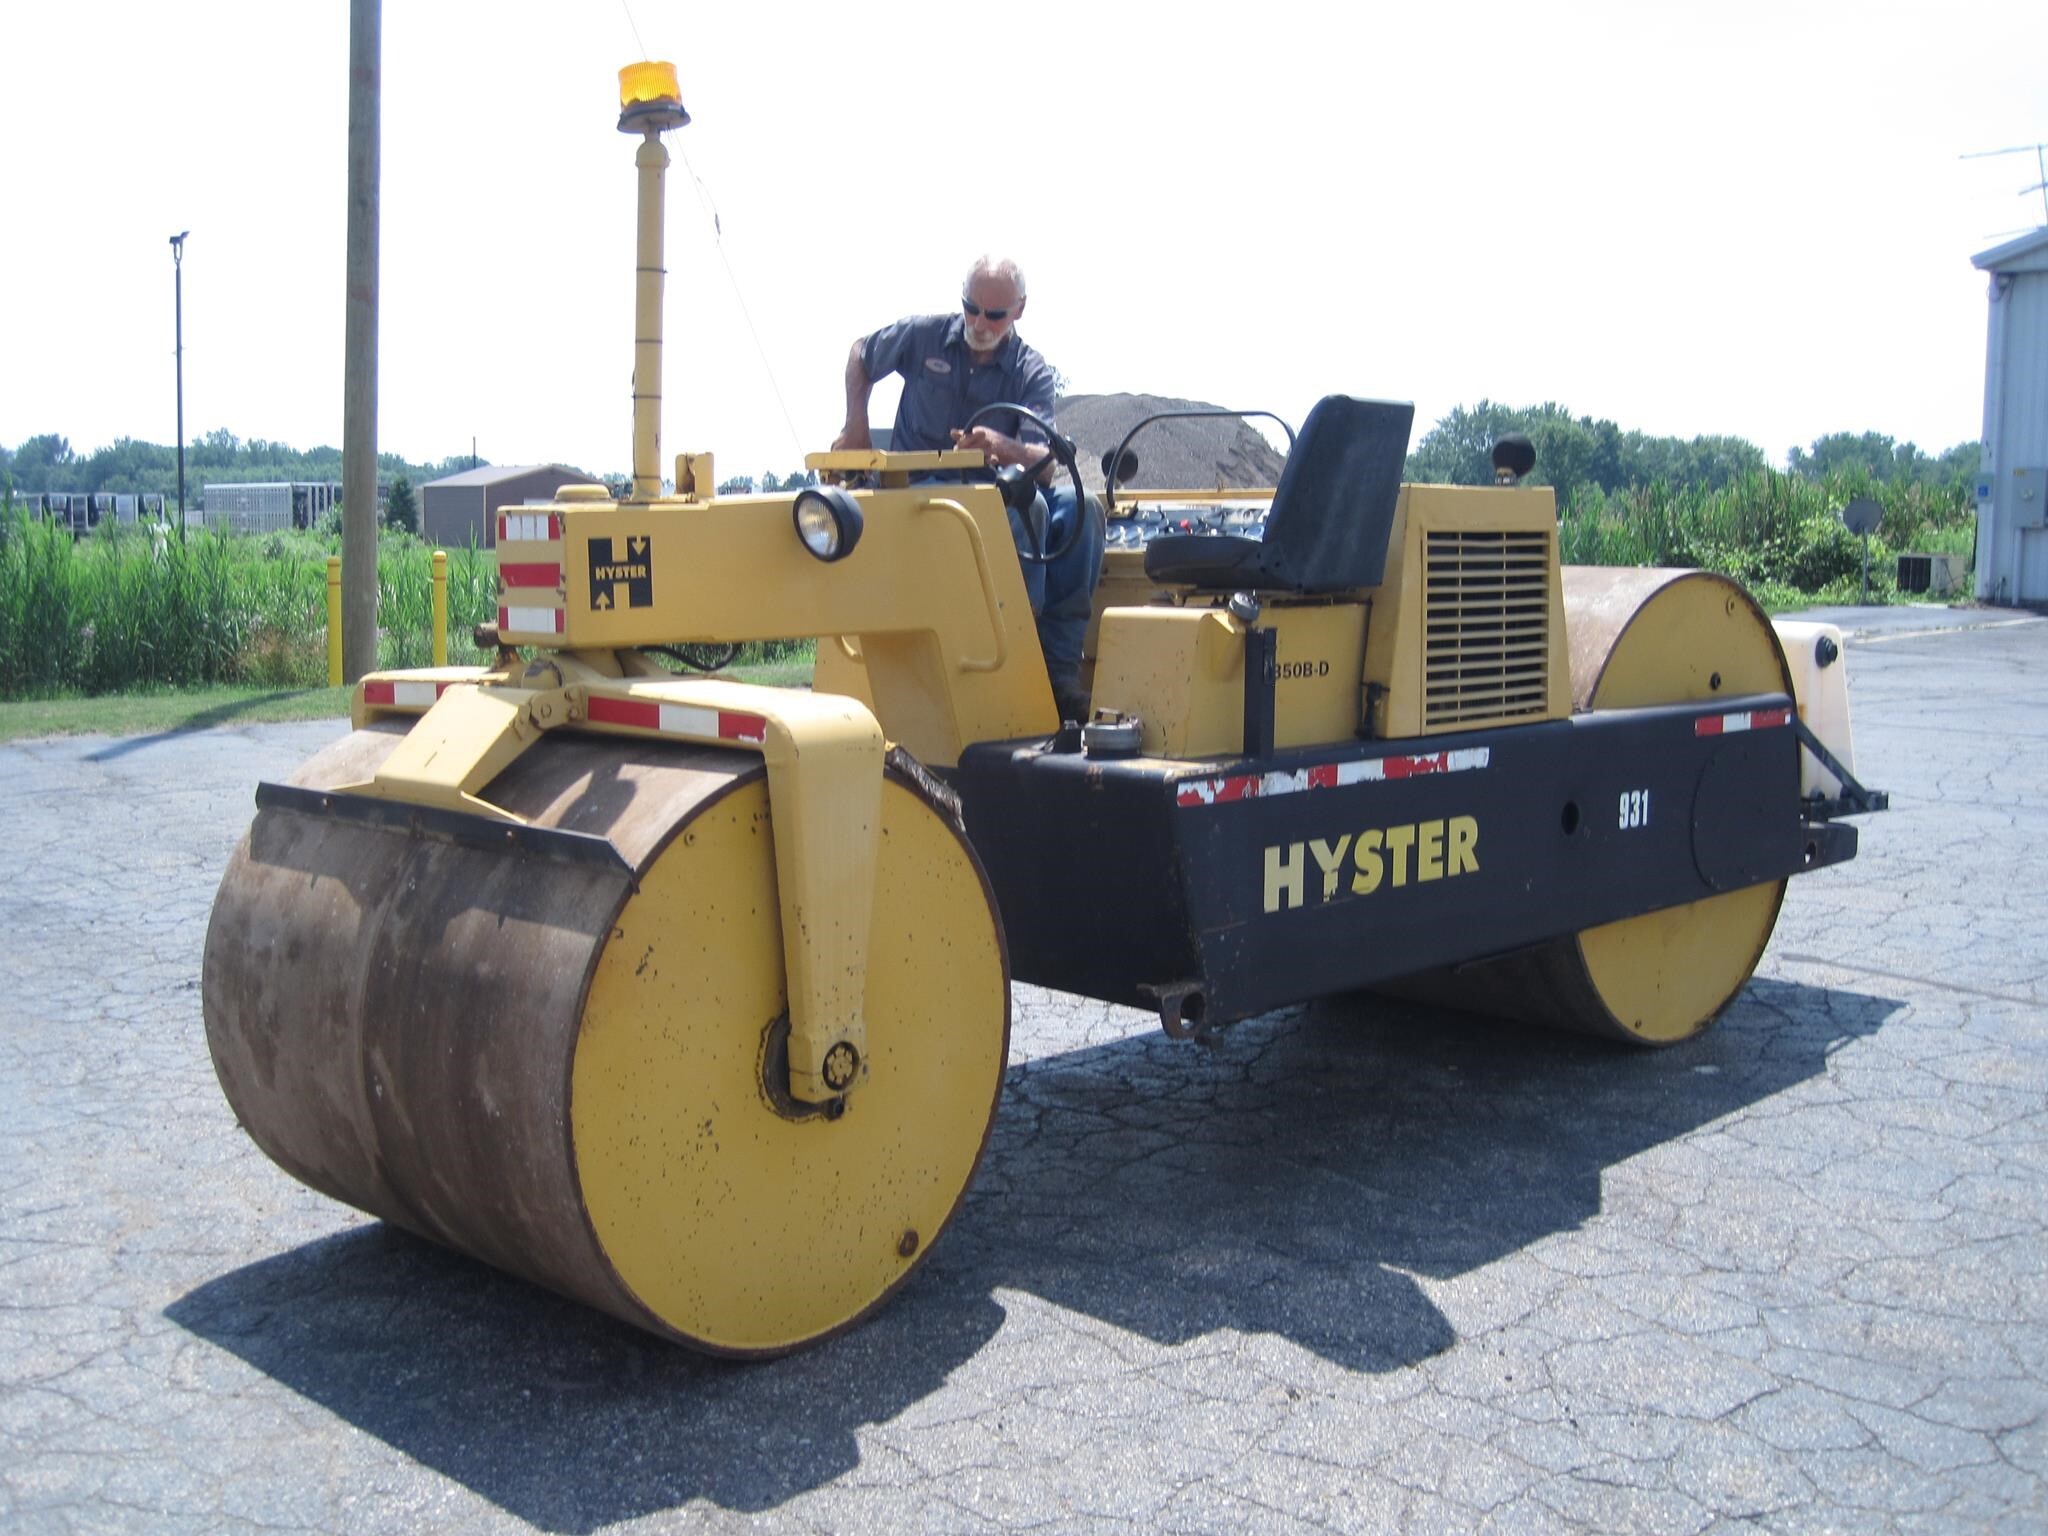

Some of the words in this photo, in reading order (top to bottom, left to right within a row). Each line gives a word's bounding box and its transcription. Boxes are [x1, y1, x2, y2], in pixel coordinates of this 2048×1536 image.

[595, 565, 647, 580] HYSTER
[1618, 788, 1649, 830] 931
[1263, 815, 1480, 914] HYSTER
